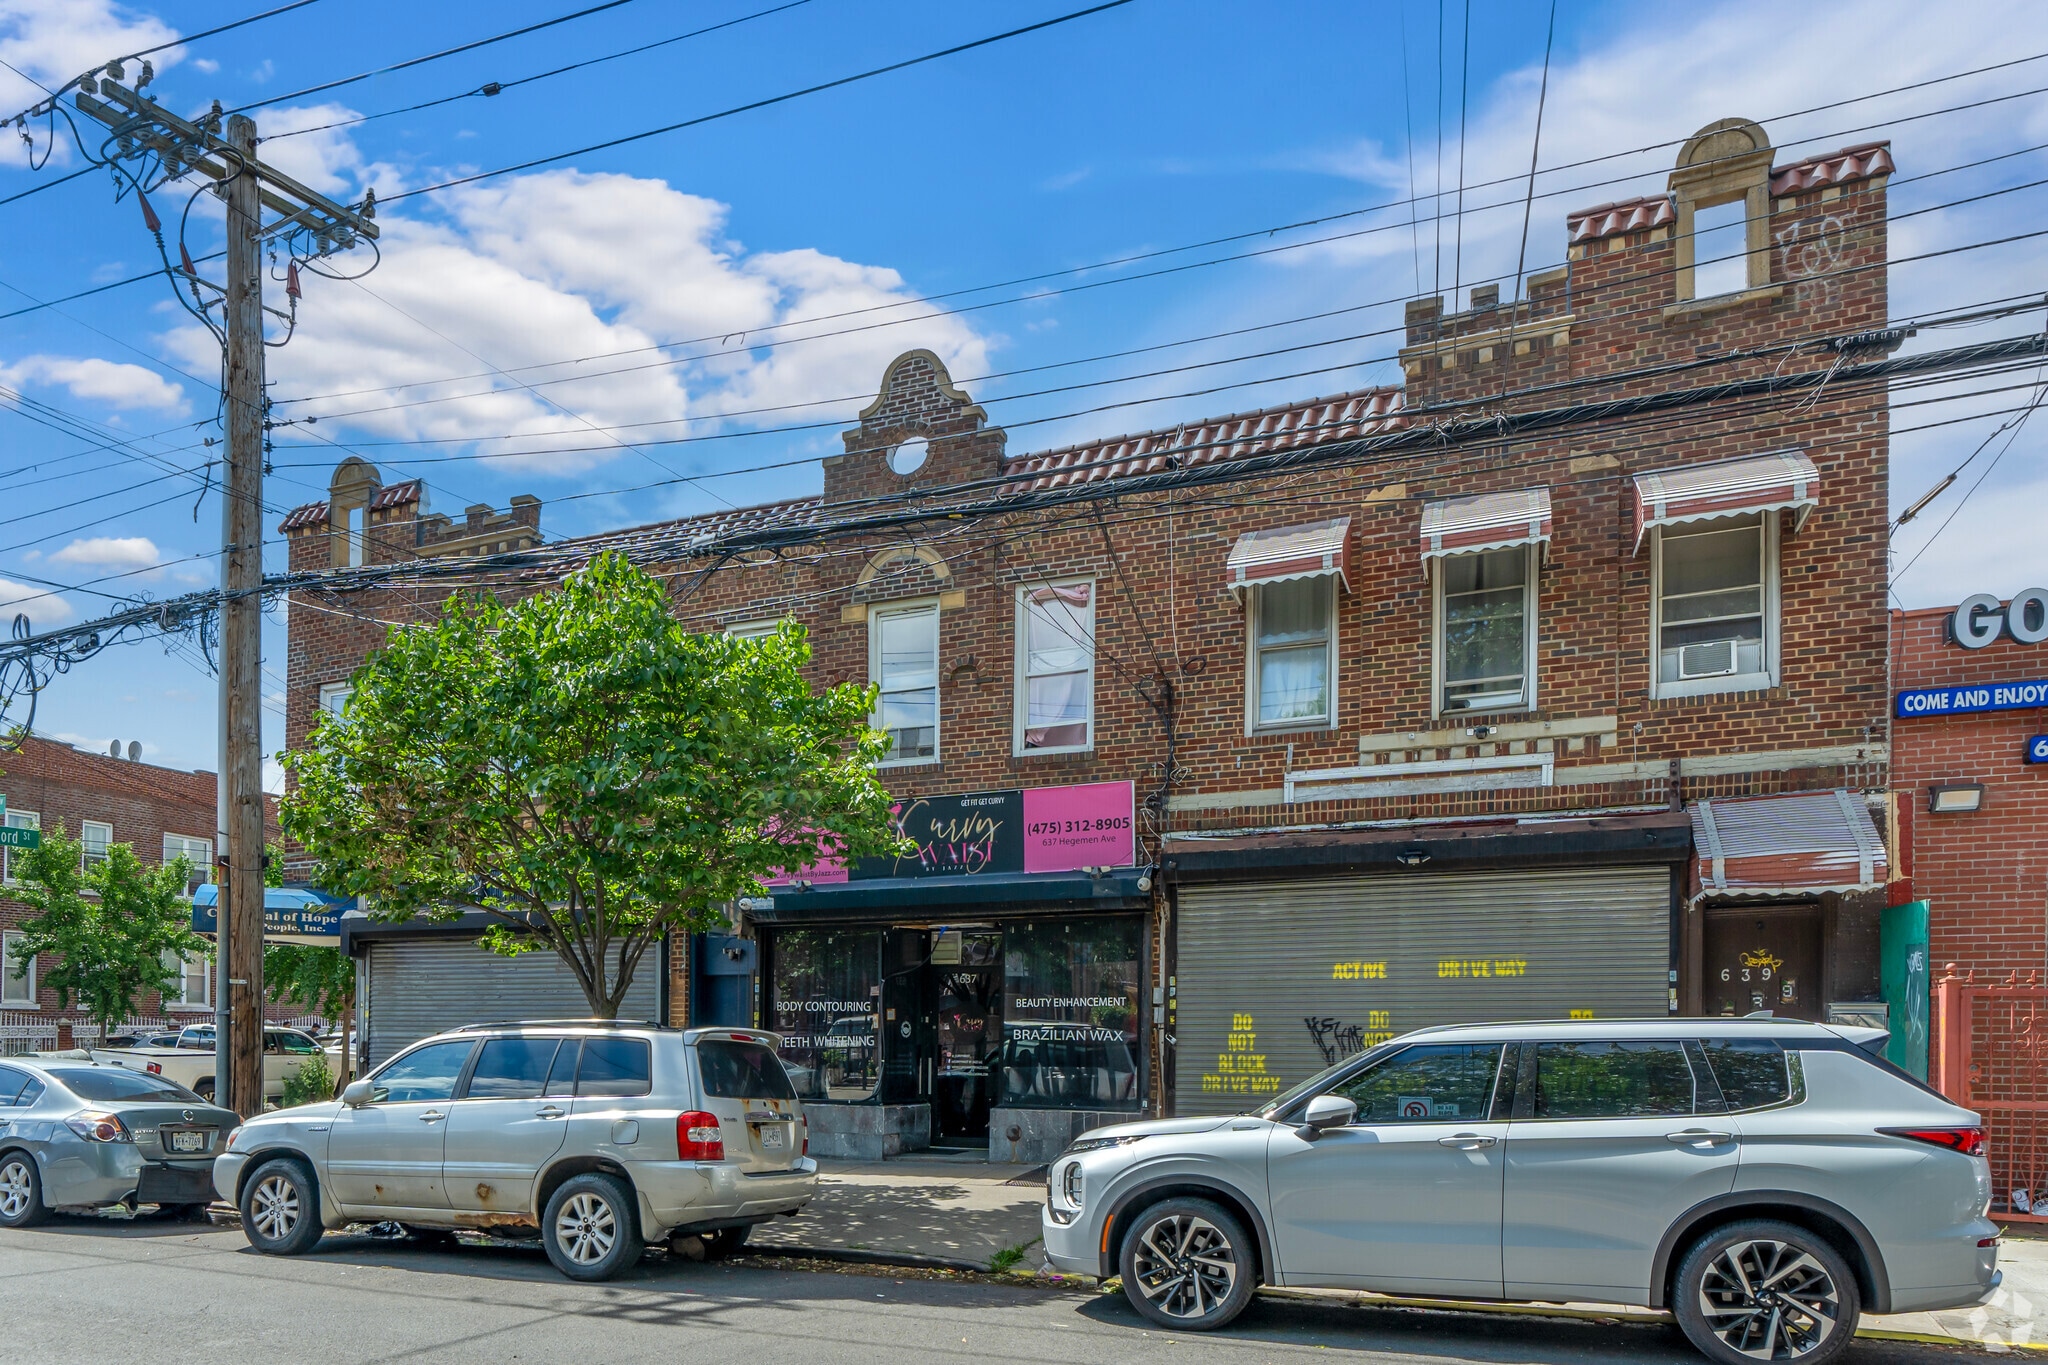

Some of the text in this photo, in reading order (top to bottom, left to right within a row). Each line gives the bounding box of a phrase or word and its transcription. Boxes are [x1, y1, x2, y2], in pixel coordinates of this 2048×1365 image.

[1904, 684, 2048, 713] COME AND ENJOY
[961, 798, 971, 807] GET
[978, 797, 988, 806] GET
[988, 796, 1005, 805] CURVY
[1027, 817, 1130, 837] (475) 312-8905
[22, 831, 31, 841] St
[894, 799, 1004, 874] Curvy
[1042, 834, 1116, 847] 637 Hegemen Ave
[283, 911, 298, 922] of
[301, 912, 338, 926] Hope
[304, 924, 326, 932] Inc.
[1332, 961, 1388, 980] ACTIVE
[959, 975, 977, 984] 637
[776, 1001, 871, 1012] BODY CONTOURING
[1016, 996, 1127, 1008] BEAUTY ENHANCEMENT
[1233, 1013, 1253, 1031] DO
[1369, 1010, 1390, 1029] DO
[779, 1035, 875, 1048] TEETH WHITENING
[1013, 1029, 1123, 1042] BRAZILIAN WAX
[1228, 1033, 1256, 1052] NOT
[1218, 1053, 1267, 1074] BLOCK
